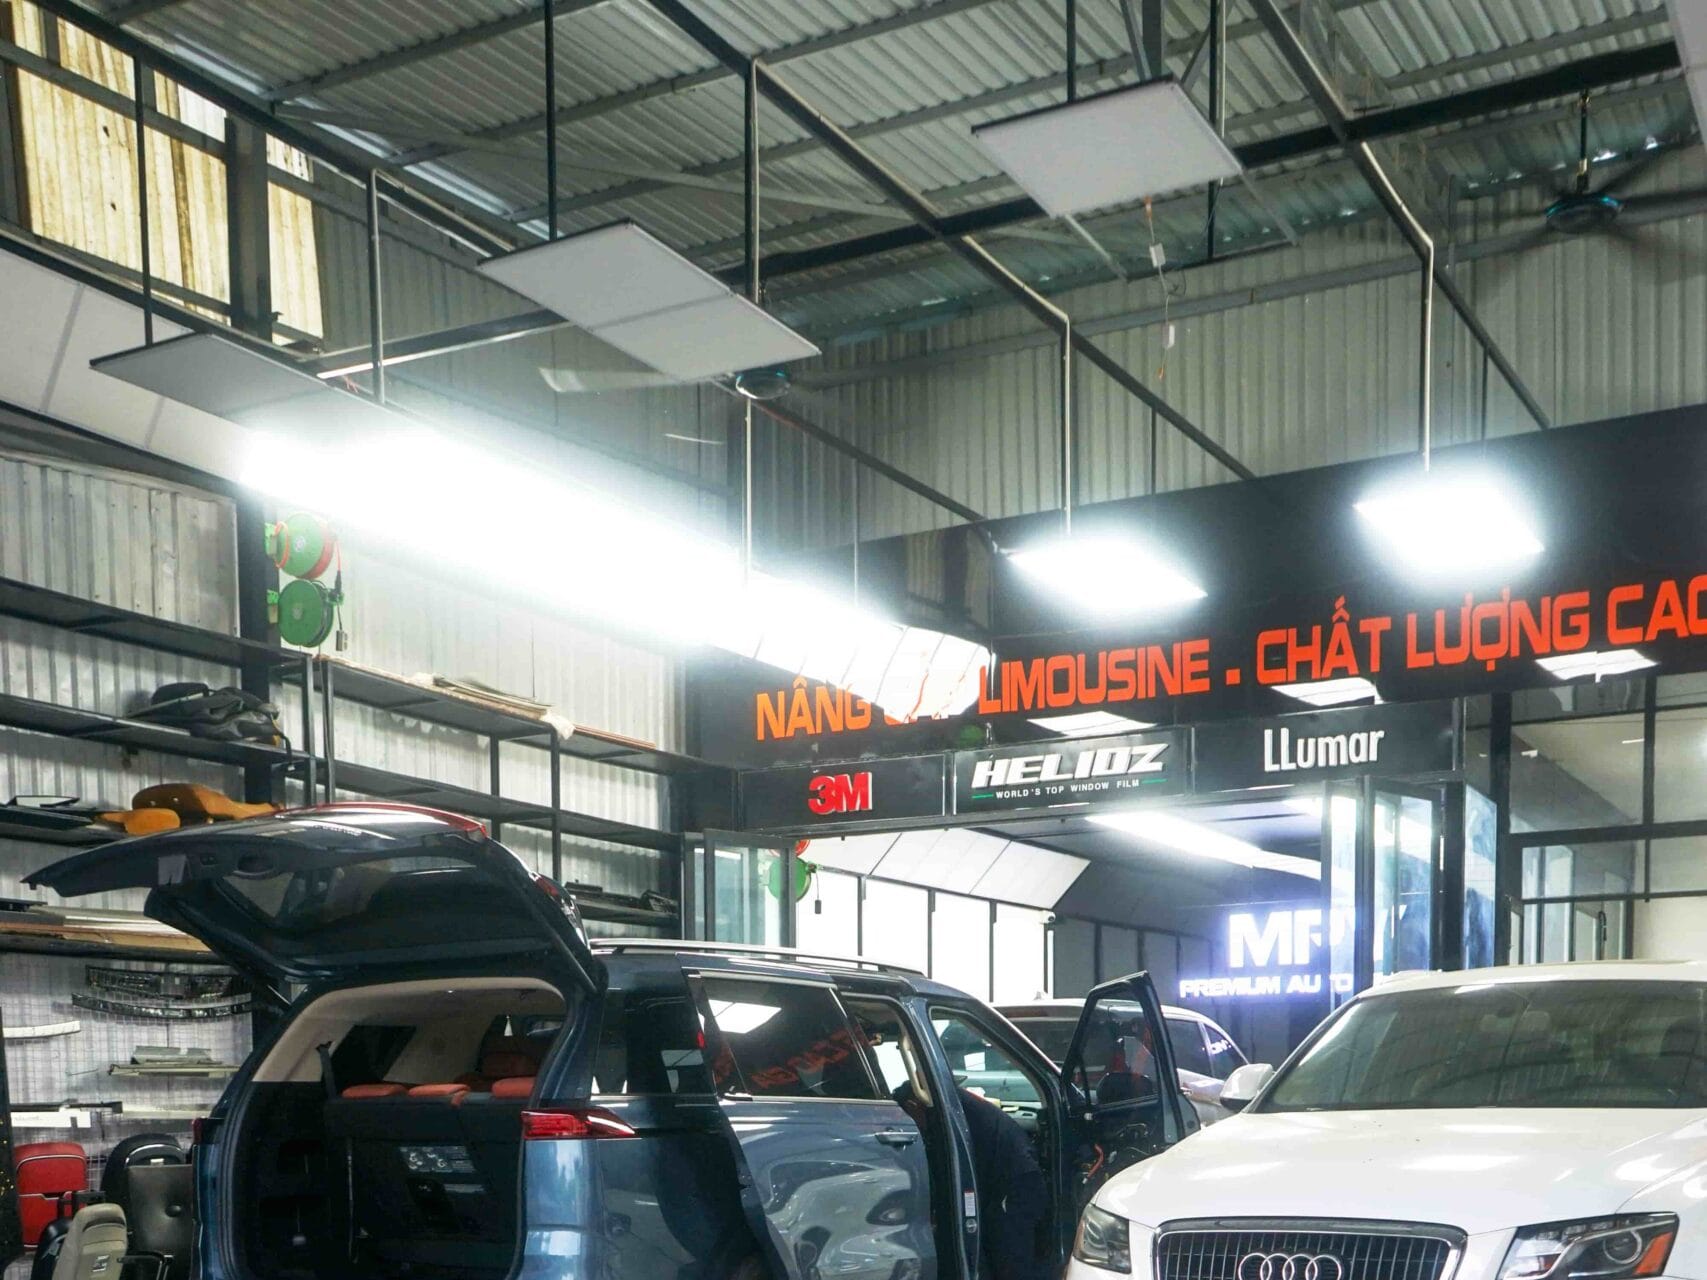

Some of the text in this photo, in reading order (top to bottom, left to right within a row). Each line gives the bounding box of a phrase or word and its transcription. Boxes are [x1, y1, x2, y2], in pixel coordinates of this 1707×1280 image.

[756, 675, 872, 741] NÂNG
[978, 638, 1211, 715] LIMOUSINE
[1256, 595, 1392, 685] CHẤT
[1406, 586, 1591, 671] LƯỢNG
[971, 743, 1169, 788] HELIOZ
[1264, 727, 1385, 772] LLumar
[808, 772, 873, 815] 3M
[996, 778, 1140, 799] WORLD'S TOP WINDOW FILM
[1180, 975, 1281, 998] PREMIUM
